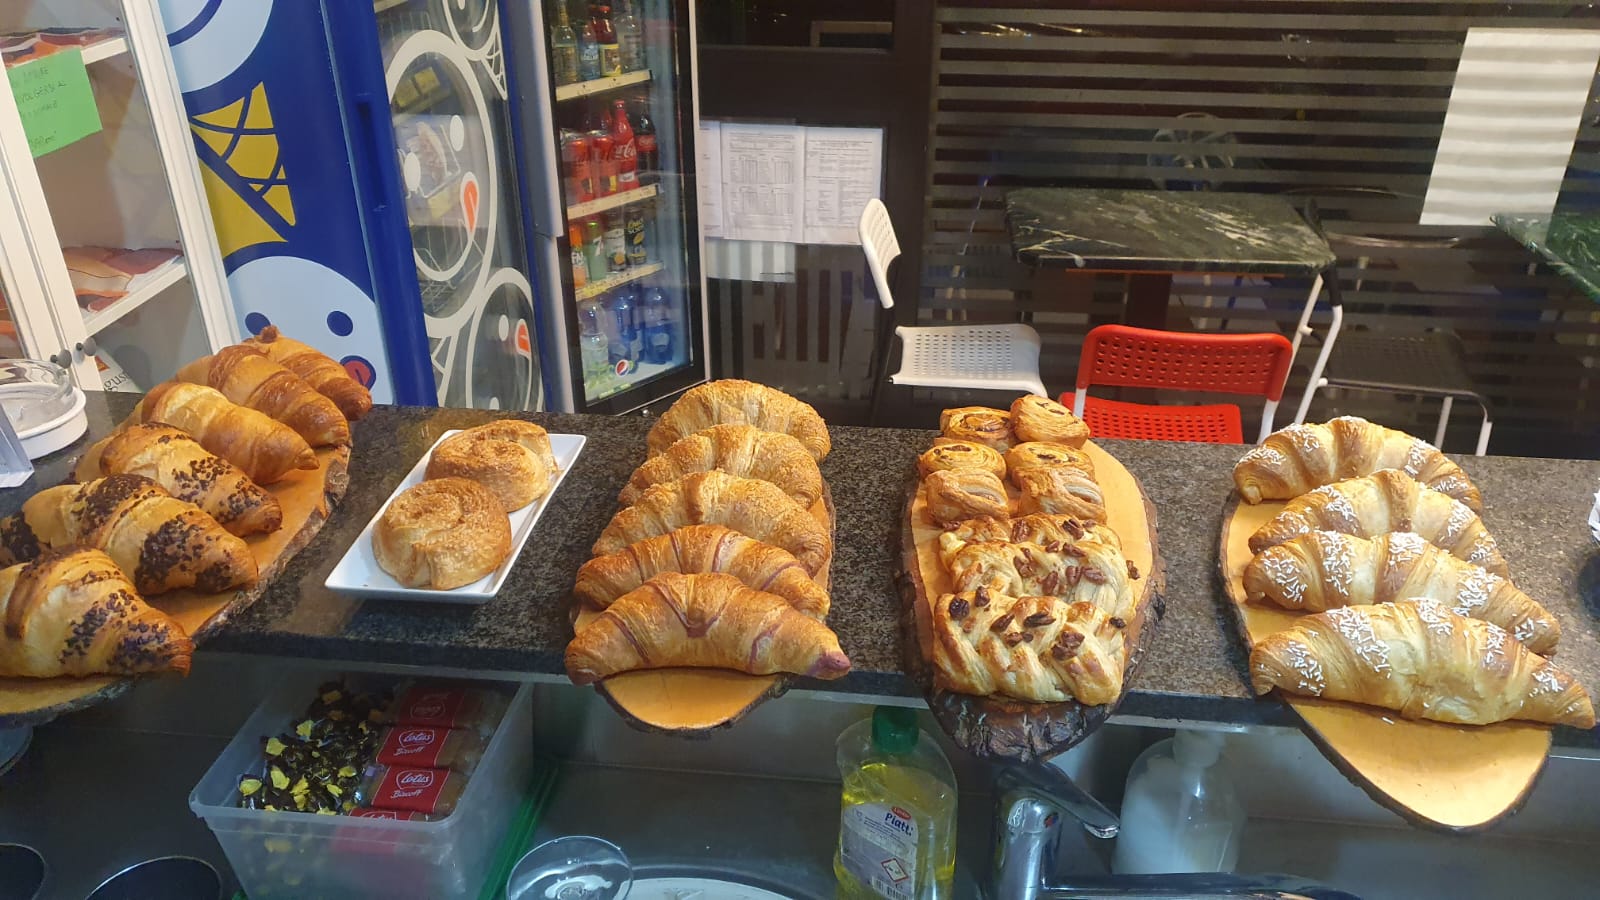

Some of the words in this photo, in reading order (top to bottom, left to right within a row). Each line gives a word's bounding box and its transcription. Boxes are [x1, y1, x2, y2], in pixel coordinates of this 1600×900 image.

[404, 731, 431, 742] Lotus
[401, 773, 430, 783] Lotus
[390, 789, 423, 799] Biscoff
